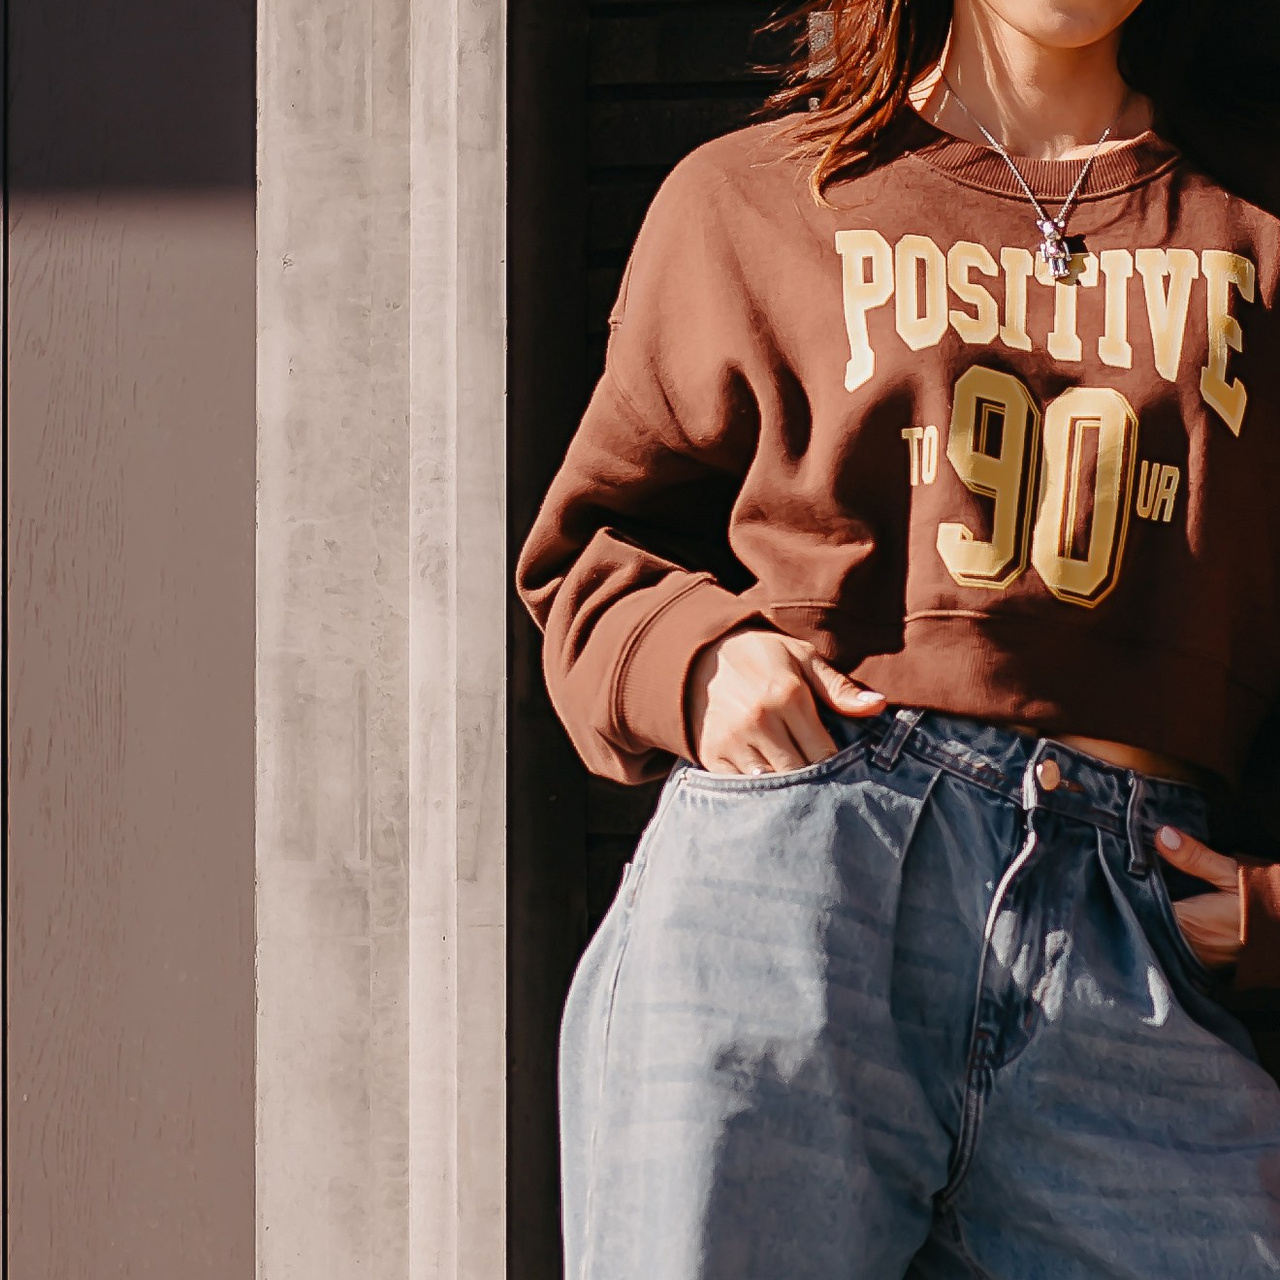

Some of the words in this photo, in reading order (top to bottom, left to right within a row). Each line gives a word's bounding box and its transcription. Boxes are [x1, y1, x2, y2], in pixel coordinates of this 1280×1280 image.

[835, 230, 1255, 437] POSITIVE
[902, 425, 939, 487] TO
[936, 365, 1139, 609] 90
[1136, 460, 1180, 523] UR
